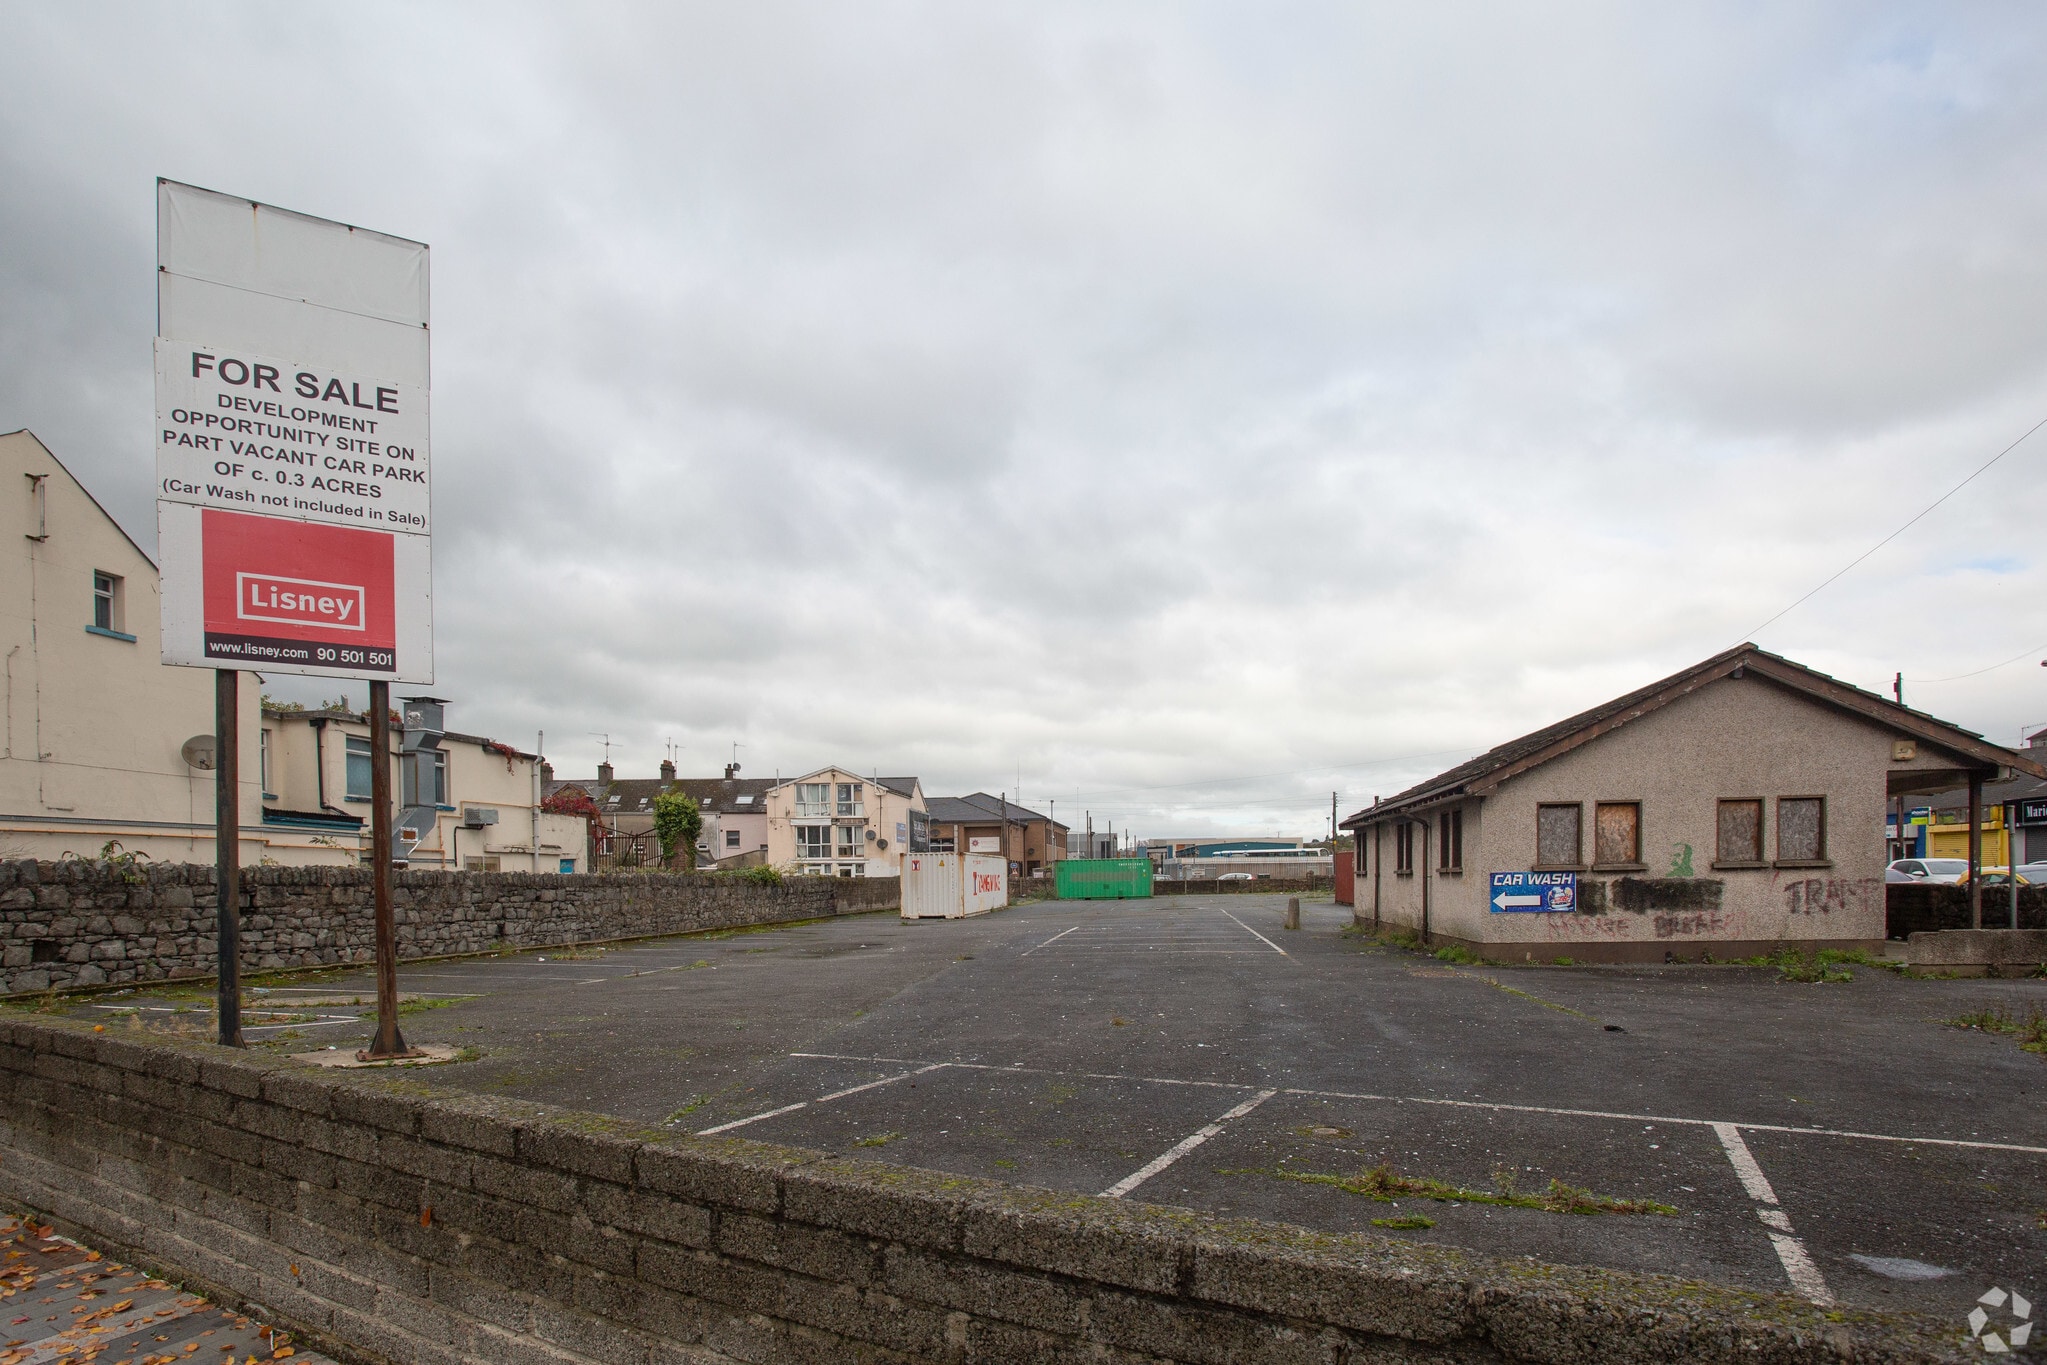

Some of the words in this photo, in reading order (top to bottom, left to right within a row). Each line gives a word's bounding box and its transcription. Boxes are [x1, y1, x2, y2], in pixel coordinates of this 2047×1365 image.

[192, 351, 282, 393] FOR
[294, 371, 400, 414] SALE
[217, 393, 378, 434] DEVELOPMENT
[171, 408, 330, 447] OPPORTUNITY
[336, 436, 380, 457] SITE
[386, 445, 415, 462] ON
[162, 429, 223, 452] PART
[229, 439, 318, 467] VACANT
[323, 456, 366, 475] CAR
[372, 464, 426, 484] PARK
[214, 461, 245, 478] OF
[251, 469, 269, 482] c.
[275, 470, 305, 487] 0.3
[311, 476, 382, 499] ACRES
[162, 478, 202, 495] (Car
[206, 484, 255, 502] Wash
[261, 493, 289, 508] not
[293, 492, 364, 518] included
[368, 506, 383, 520] in
[387, 510, 426, 529] Sale)
[251, 583, 355, 621] Lisney
[209, 641, 309, 660] www.lisney.com
[316, 647, 336, 662] 90
[340, 649, 364, 664] 501
[369, 652, 392, 666] 501
[1493, 874, 1523, 886] CAR
[1527, 873, 1573, 885] WASH
